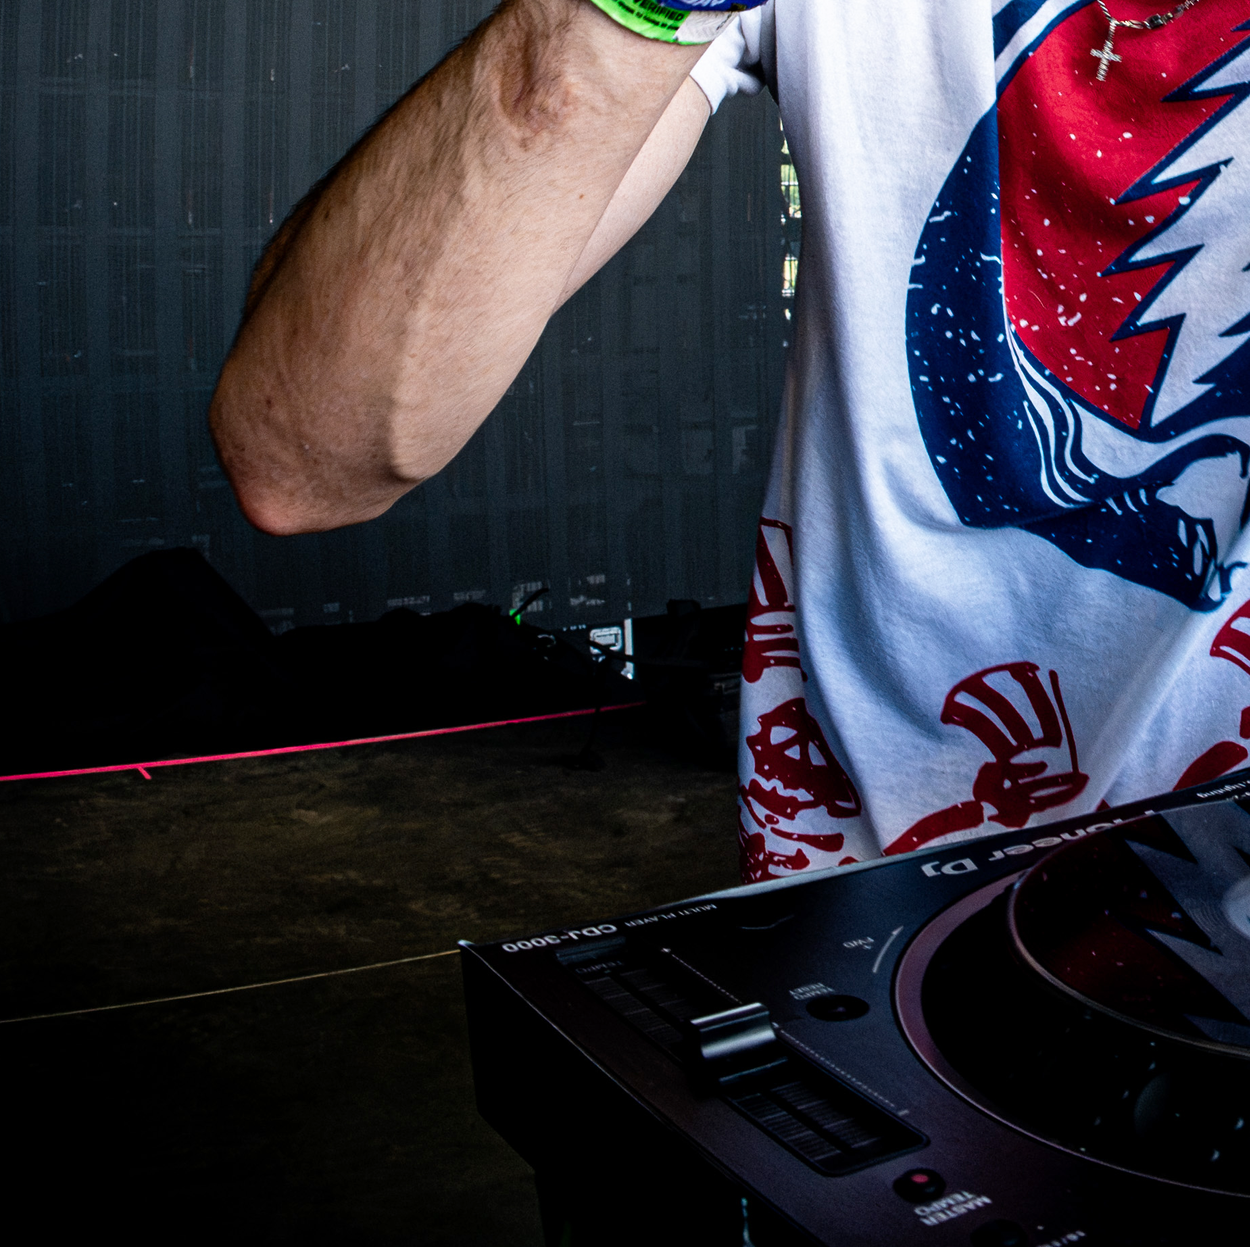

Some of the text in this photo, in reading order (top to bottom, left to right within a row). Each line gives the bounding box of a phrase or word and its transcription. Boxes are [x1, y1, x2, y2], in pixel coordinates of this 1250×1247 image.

[921, 810, 1156, 879] oneer DJ
[624, 902, 718, 928] MULTI PLAYER
[501, 923, 618, 953] CDJ-3000
[914, 1190, 973, 1216] TEMPO
[919, 1194, 993, 1227] MASTER
